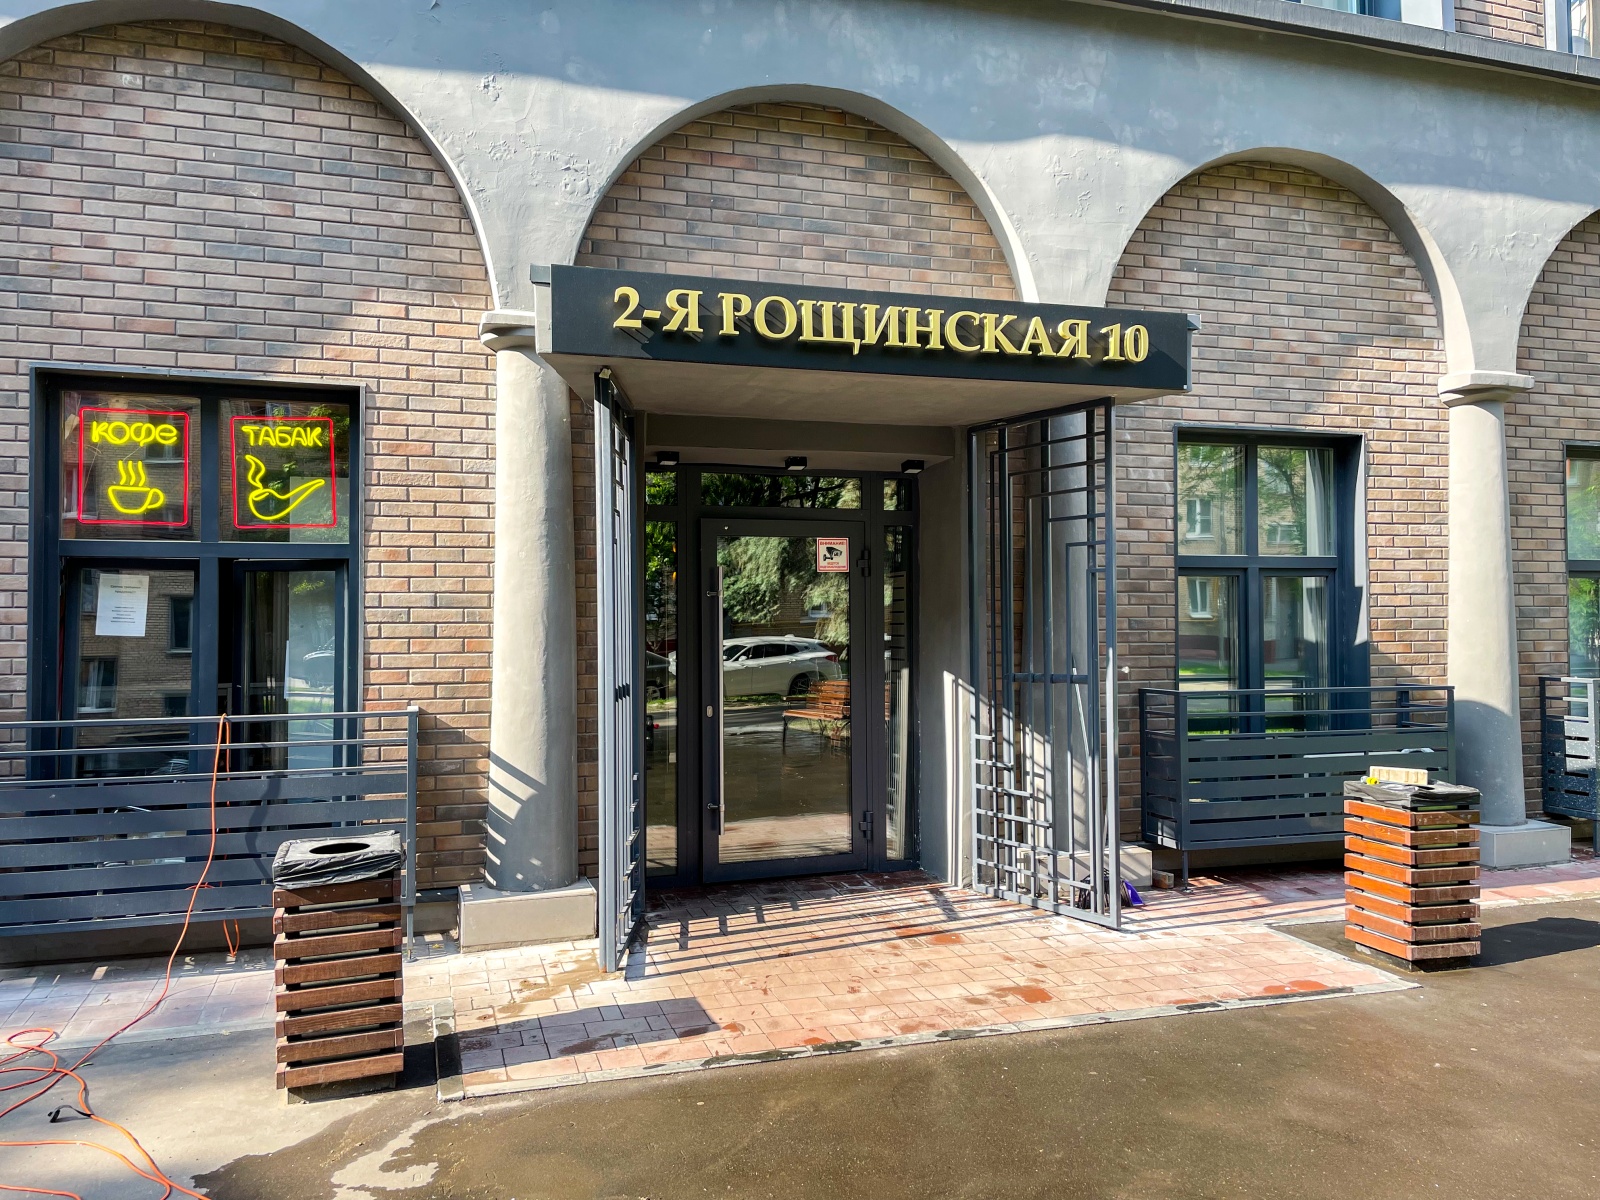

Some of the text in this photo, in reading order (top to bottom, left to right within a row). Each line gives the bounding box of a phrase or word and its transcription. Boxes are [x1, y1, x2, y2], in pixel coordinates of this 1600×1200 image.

[613, 286, 1149, 363] 2-Я РОЩИНСКАЯ 10
[242, 425, 323, 447] ТАБАК
